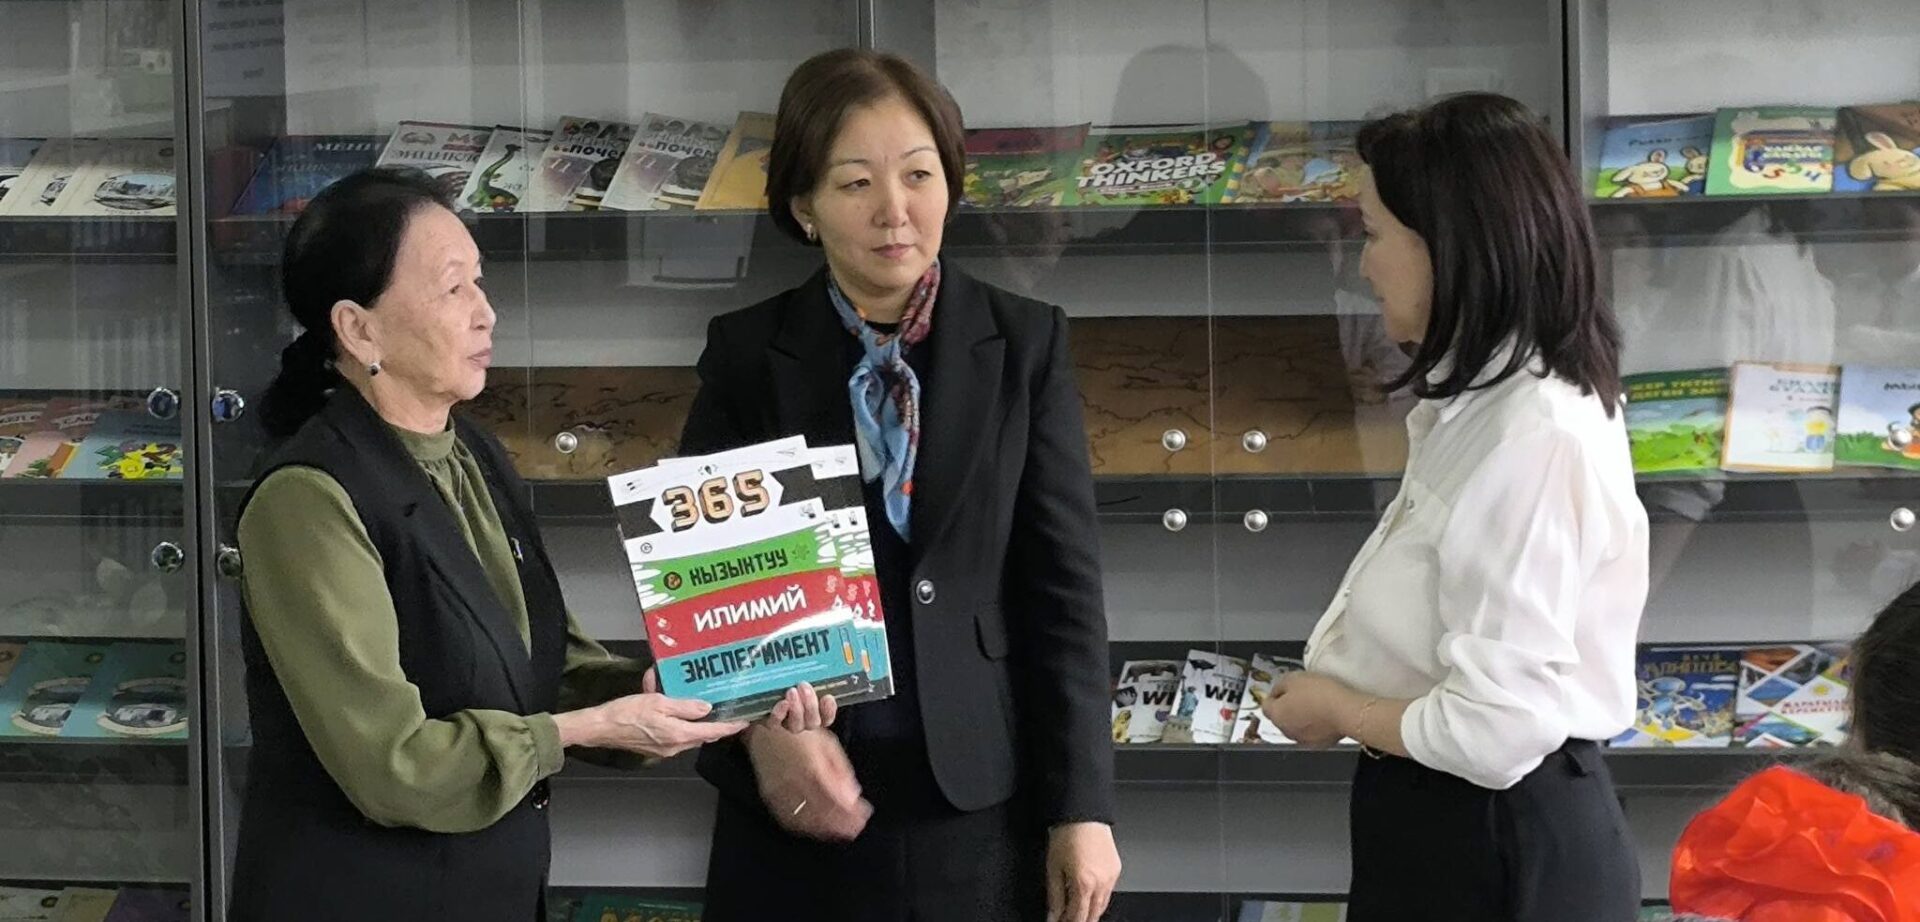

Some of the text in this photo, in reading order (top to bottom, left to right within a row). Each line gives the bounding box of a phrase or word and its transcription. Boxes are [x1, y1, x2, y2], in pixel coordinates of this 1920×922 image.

[1075, 160, 1227, 188] THINKERS
[1090, 151, 1218, 175] OXFORD
[662, 469, 770, 533] 365
[689, 548, 789, 587] КЫЗЫКТУУ
[693, 583, 807, 632] ИЛИМИЙ
[679, 628, 832, 684] ЭКСПЕРИМЕНТ
